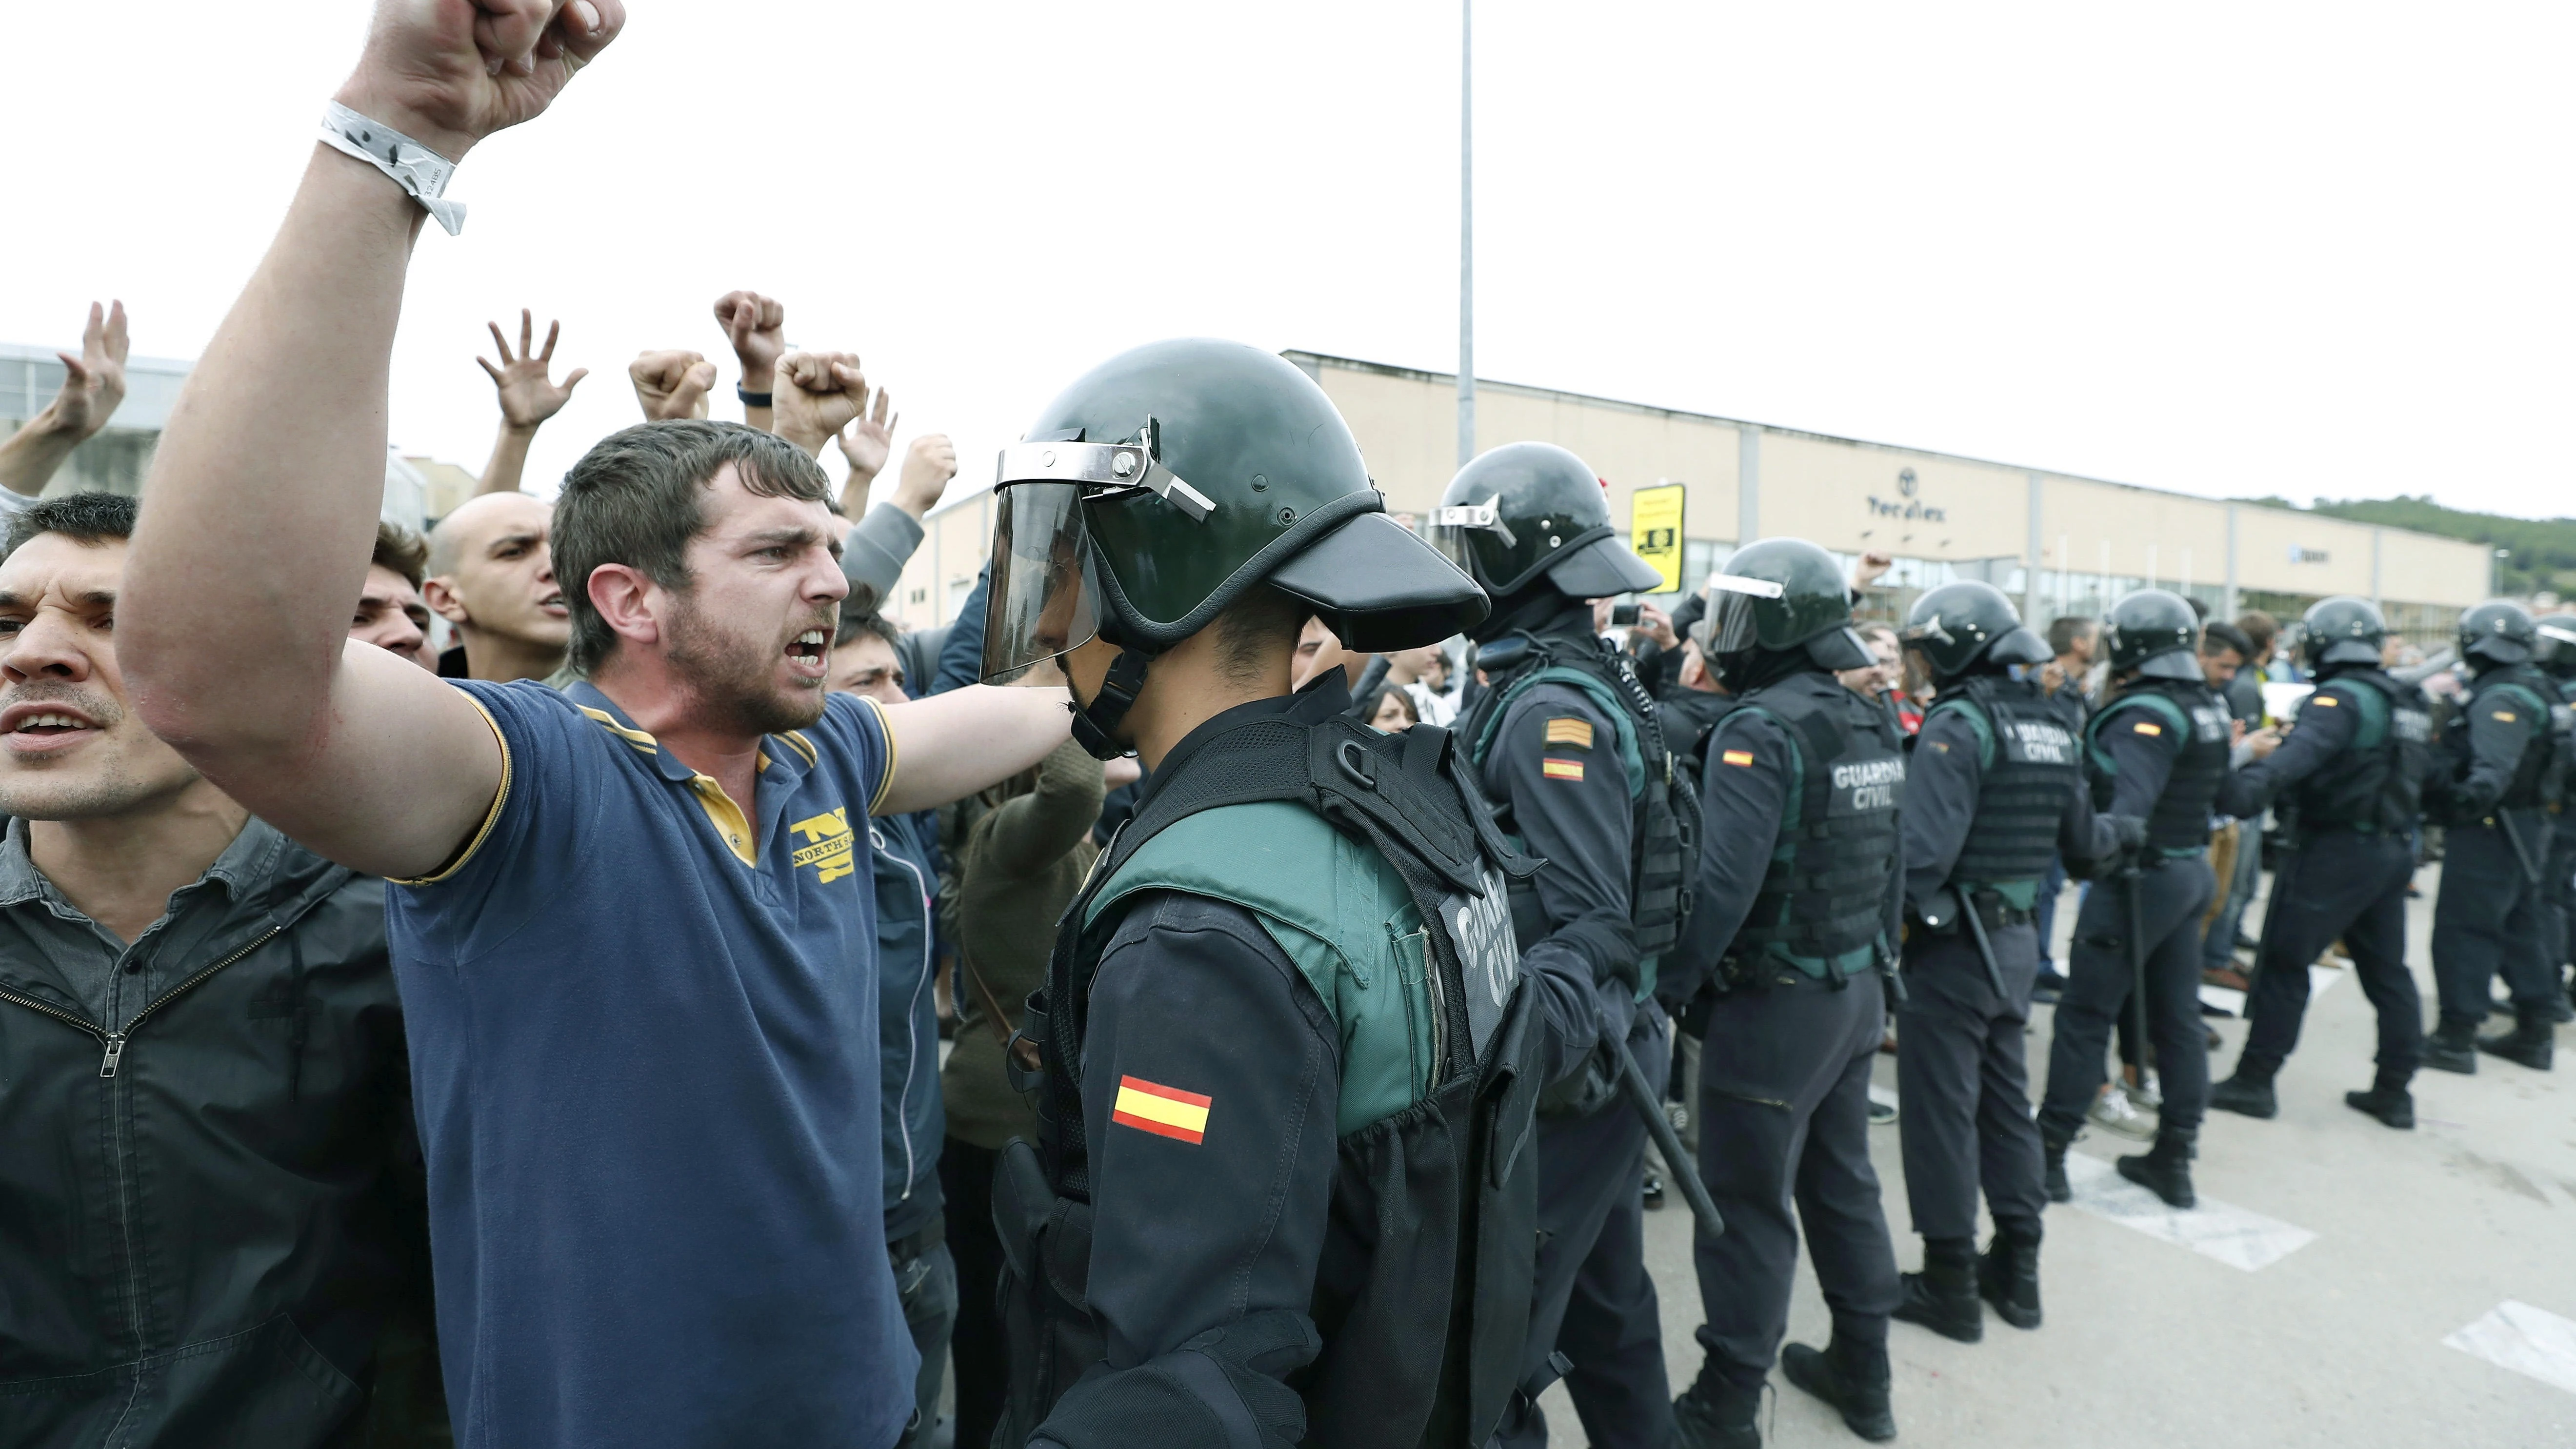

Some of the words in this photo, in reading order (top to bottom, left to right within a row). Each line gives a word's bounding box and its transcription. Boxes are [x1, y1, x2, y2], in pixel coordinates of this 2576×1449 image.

[1834, 758, 1906, 789] GUARDIA
[1852, 785, 1894, 811] CIVIL
[793, 838, 844, 864] NORTH
